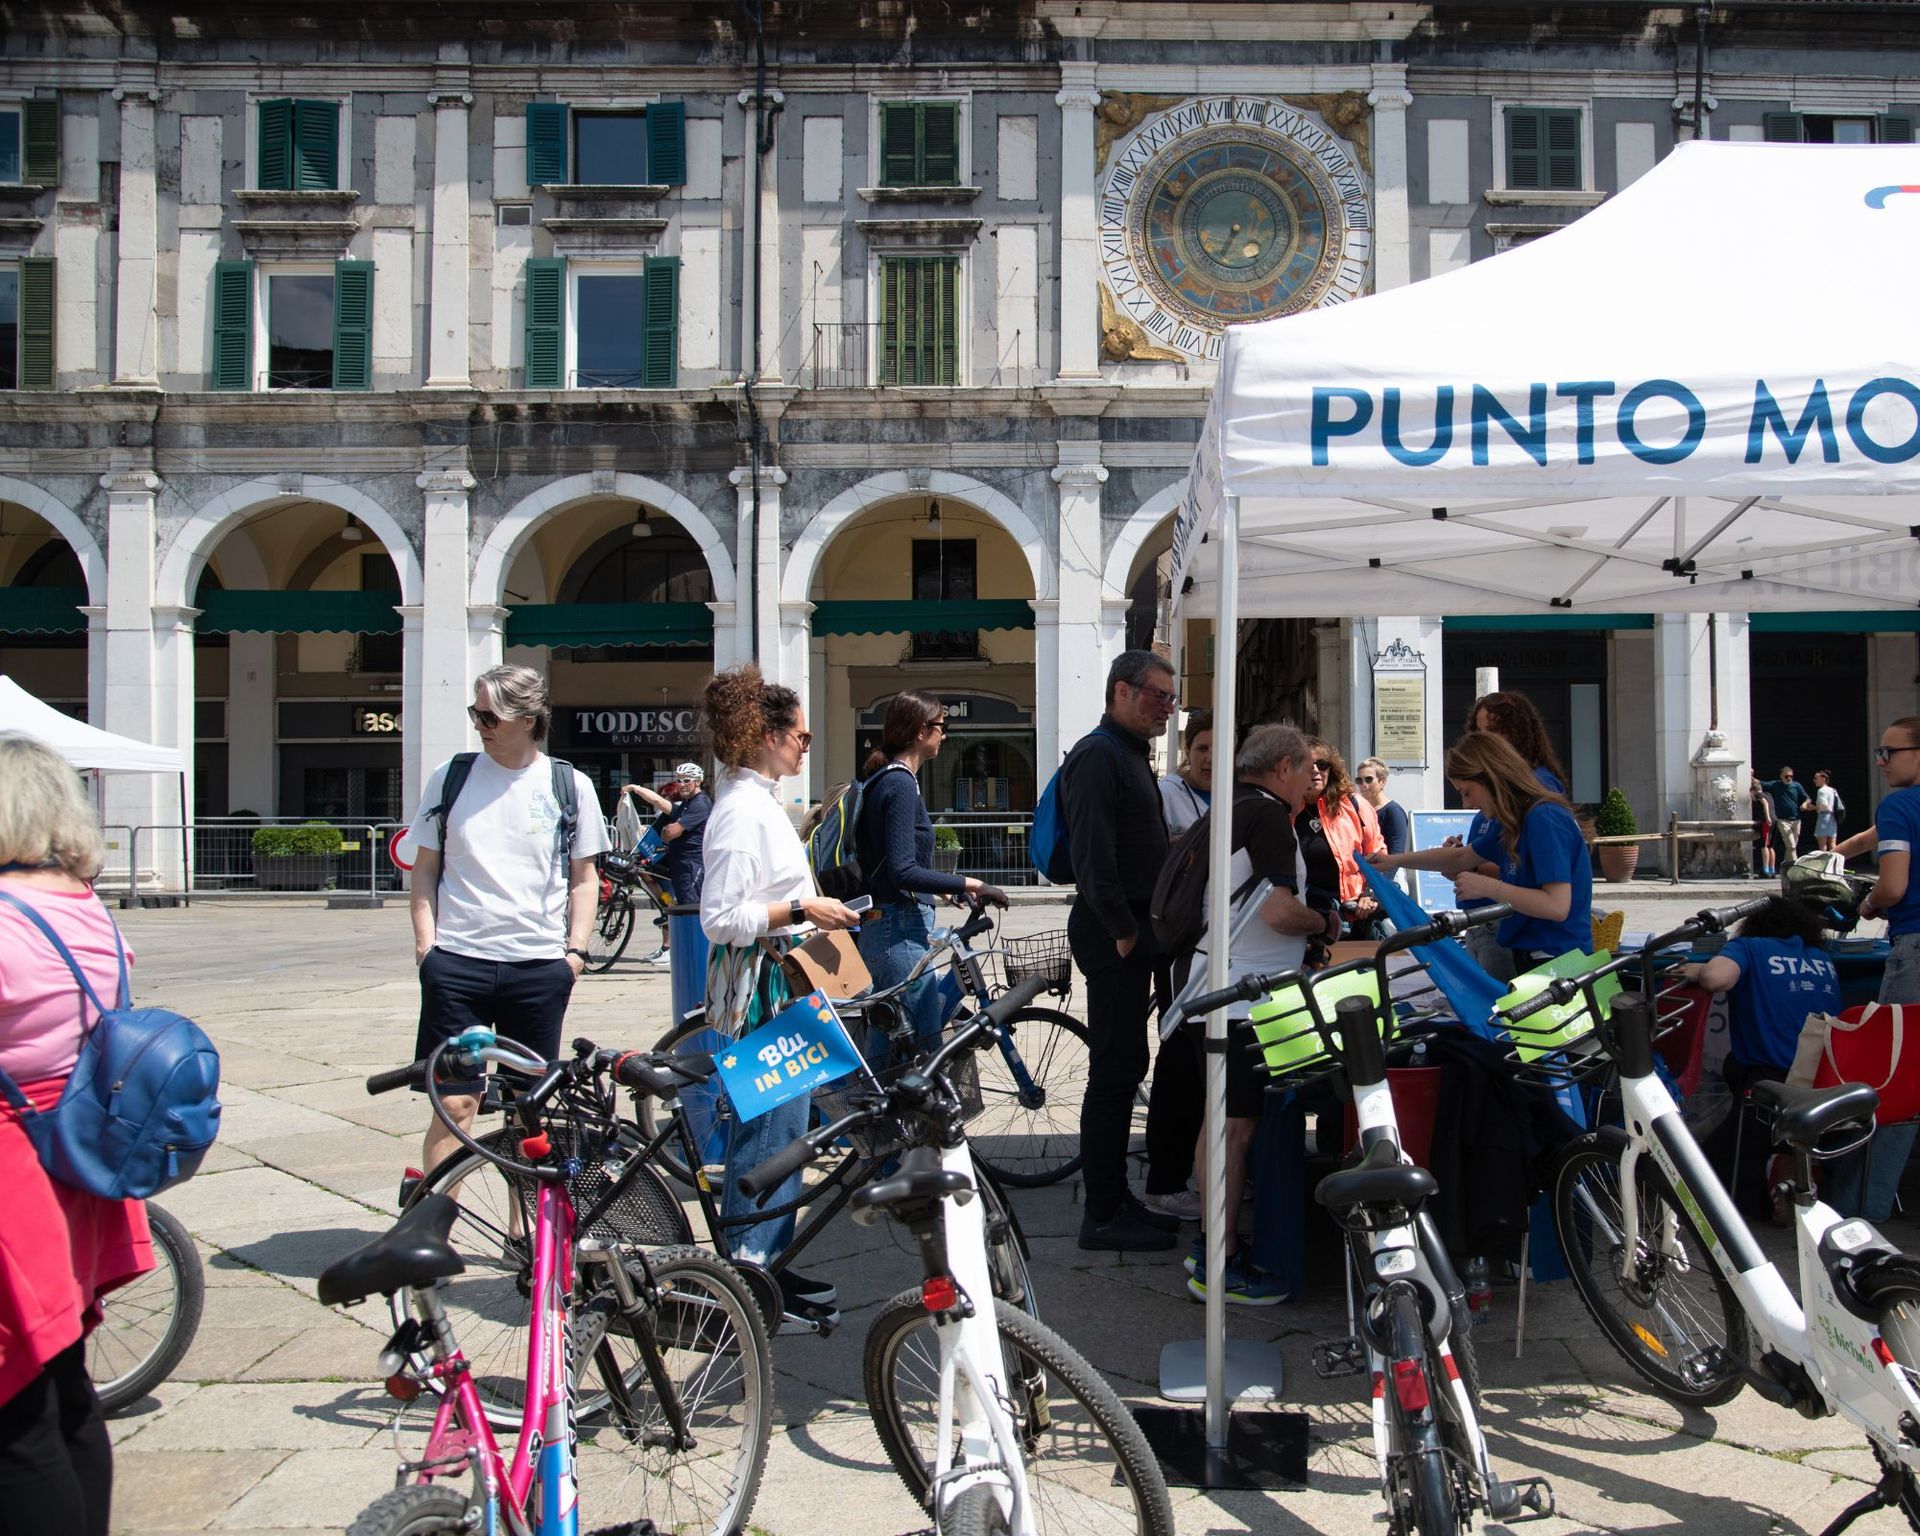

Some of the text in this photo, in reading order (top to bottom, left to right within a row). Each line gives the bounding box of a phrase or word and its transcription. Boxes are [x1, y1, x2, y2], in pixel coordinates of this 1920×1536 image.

[1144, 119, 1174, 149] XVI
[1268, 107, 1294, 133] XX
[1311, 378, 1707, 468] PUNTO
[612, 734, 665, 743] PUNTO
[1768, 955, 1837, 980] STAFF
[757, 1032, 809, 1067] Blu
[754, 1069, 782, 1093] IN
[785, 1041, 830, 1078] BICI
